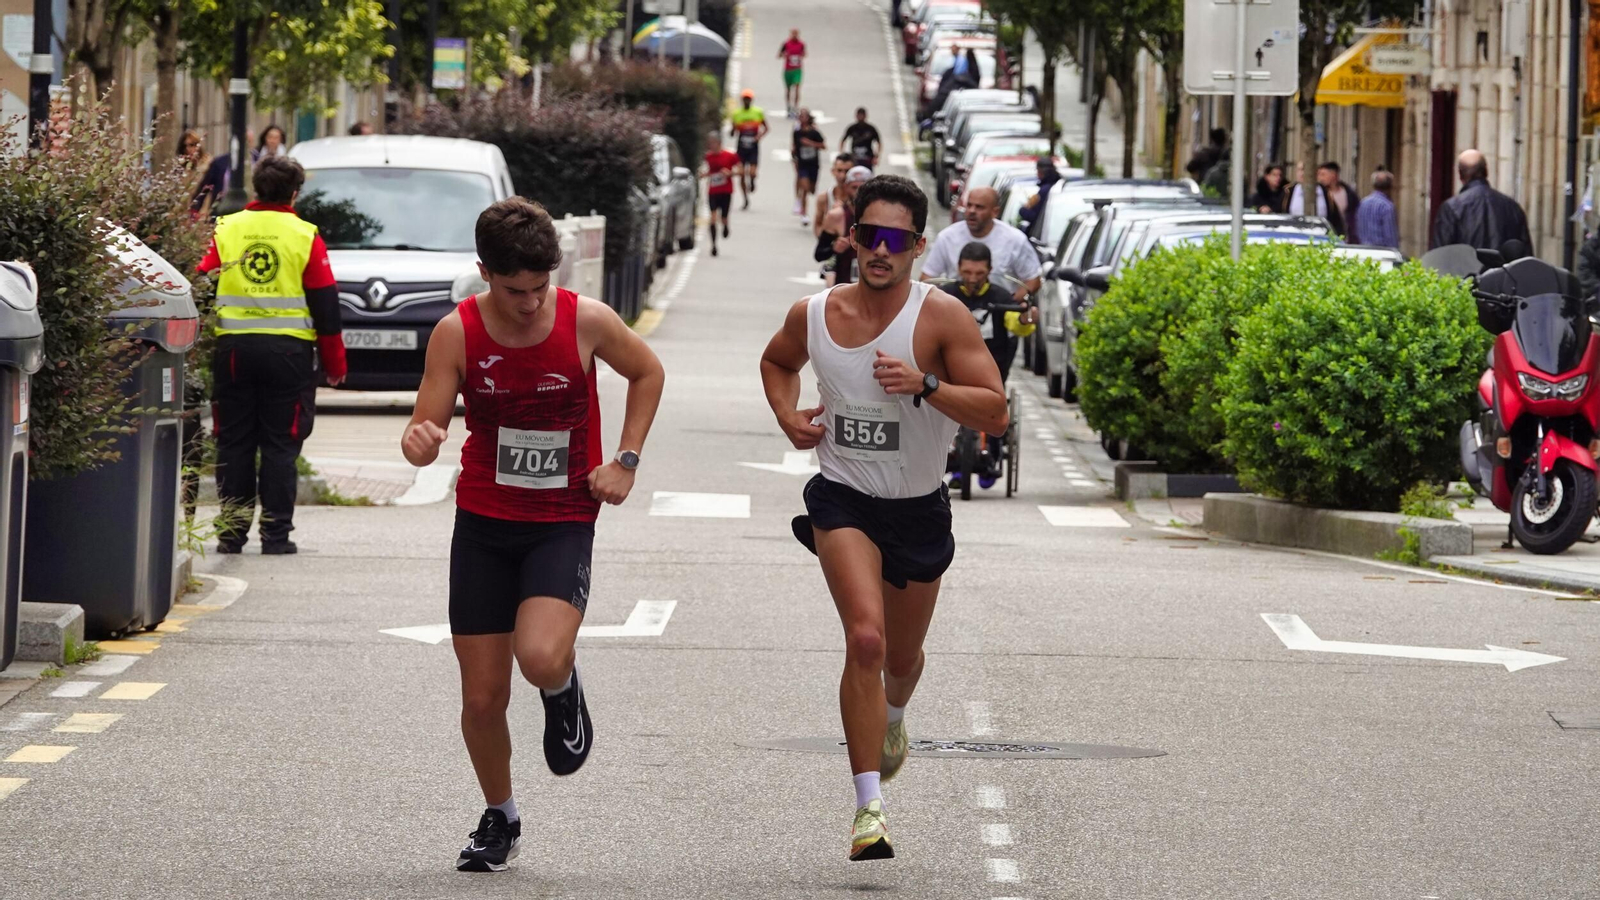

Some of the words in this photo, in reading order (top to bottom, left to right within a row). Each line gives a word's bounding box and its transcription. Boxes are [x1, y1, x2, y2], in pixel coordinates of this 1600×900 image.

[1338, 77, 1402, 92] BREZO
[344, 332, 382, 346] 0700
[386, 333, 412, 346] JHL
[537, 383, 568, 392] DEPORTE
[843, 419, 887, 445] 556
[510, 448, 559, 472] 704
